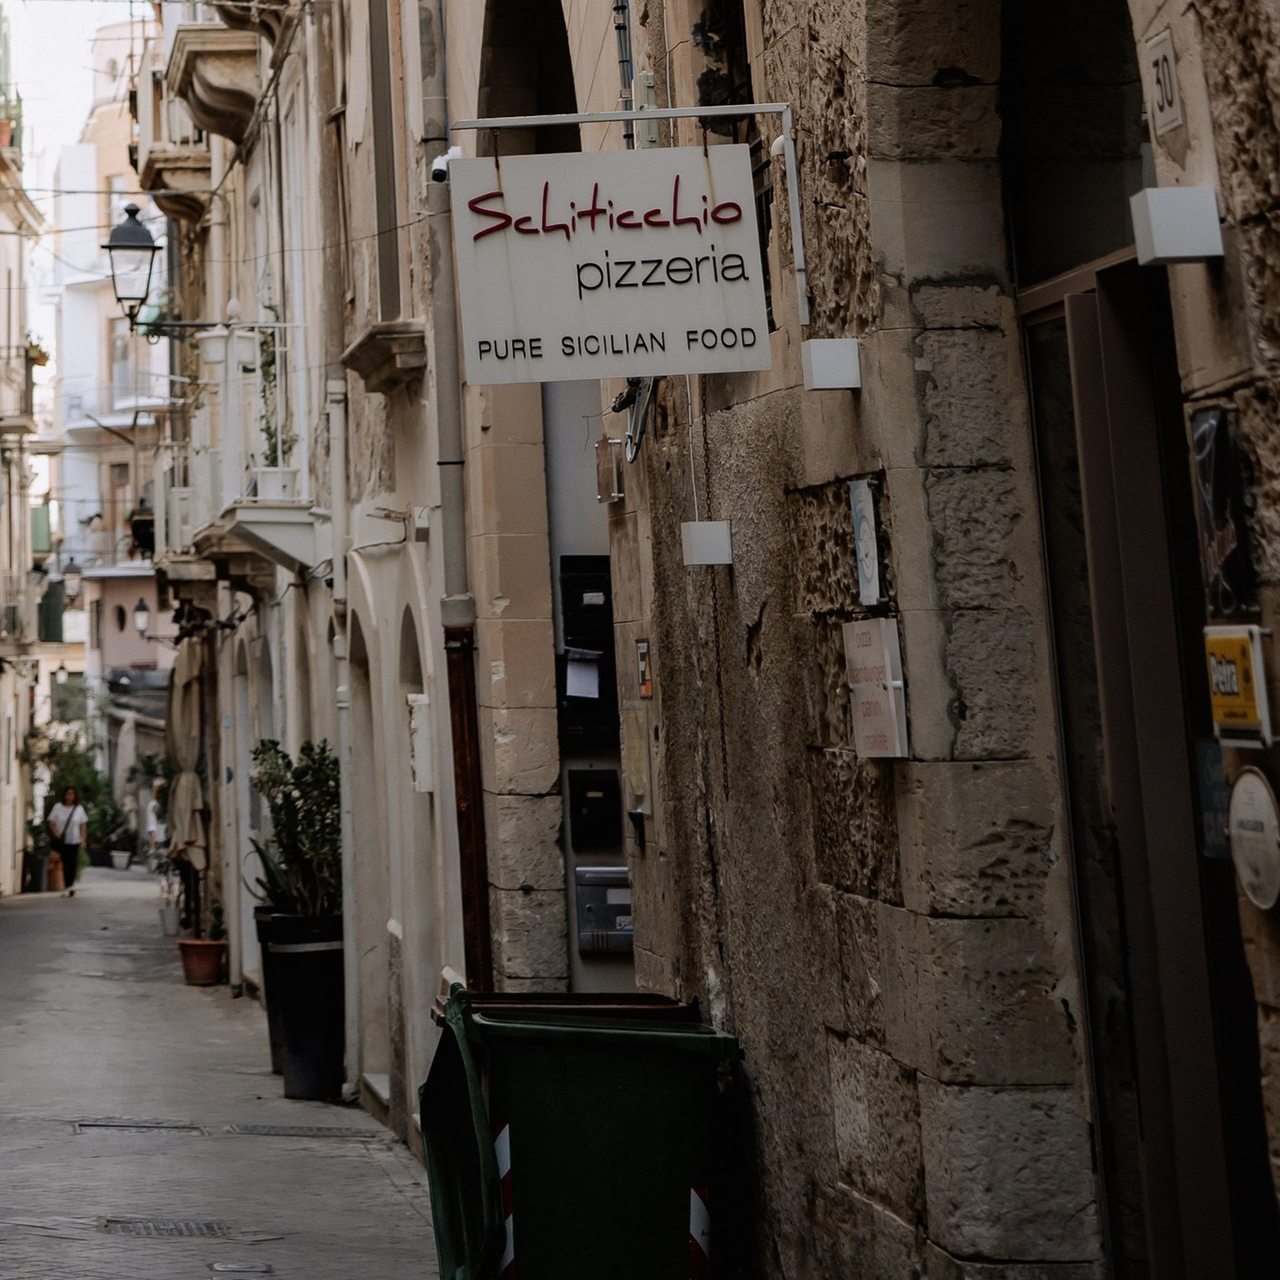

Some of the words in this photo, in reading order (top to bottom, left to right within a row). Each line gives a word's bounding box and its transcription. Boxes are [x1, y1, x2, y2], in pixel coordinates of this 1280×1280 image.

[1152, 54, 1174, 112] 30
[468, 174, 743, 240] Schiticchio
[576, 244, 750, 300] pizzeria
[478, 339, 543, 361] PURE
[561, 332, 666, 356] SICILIAN
[686, 327, 756, 350] FOOD
